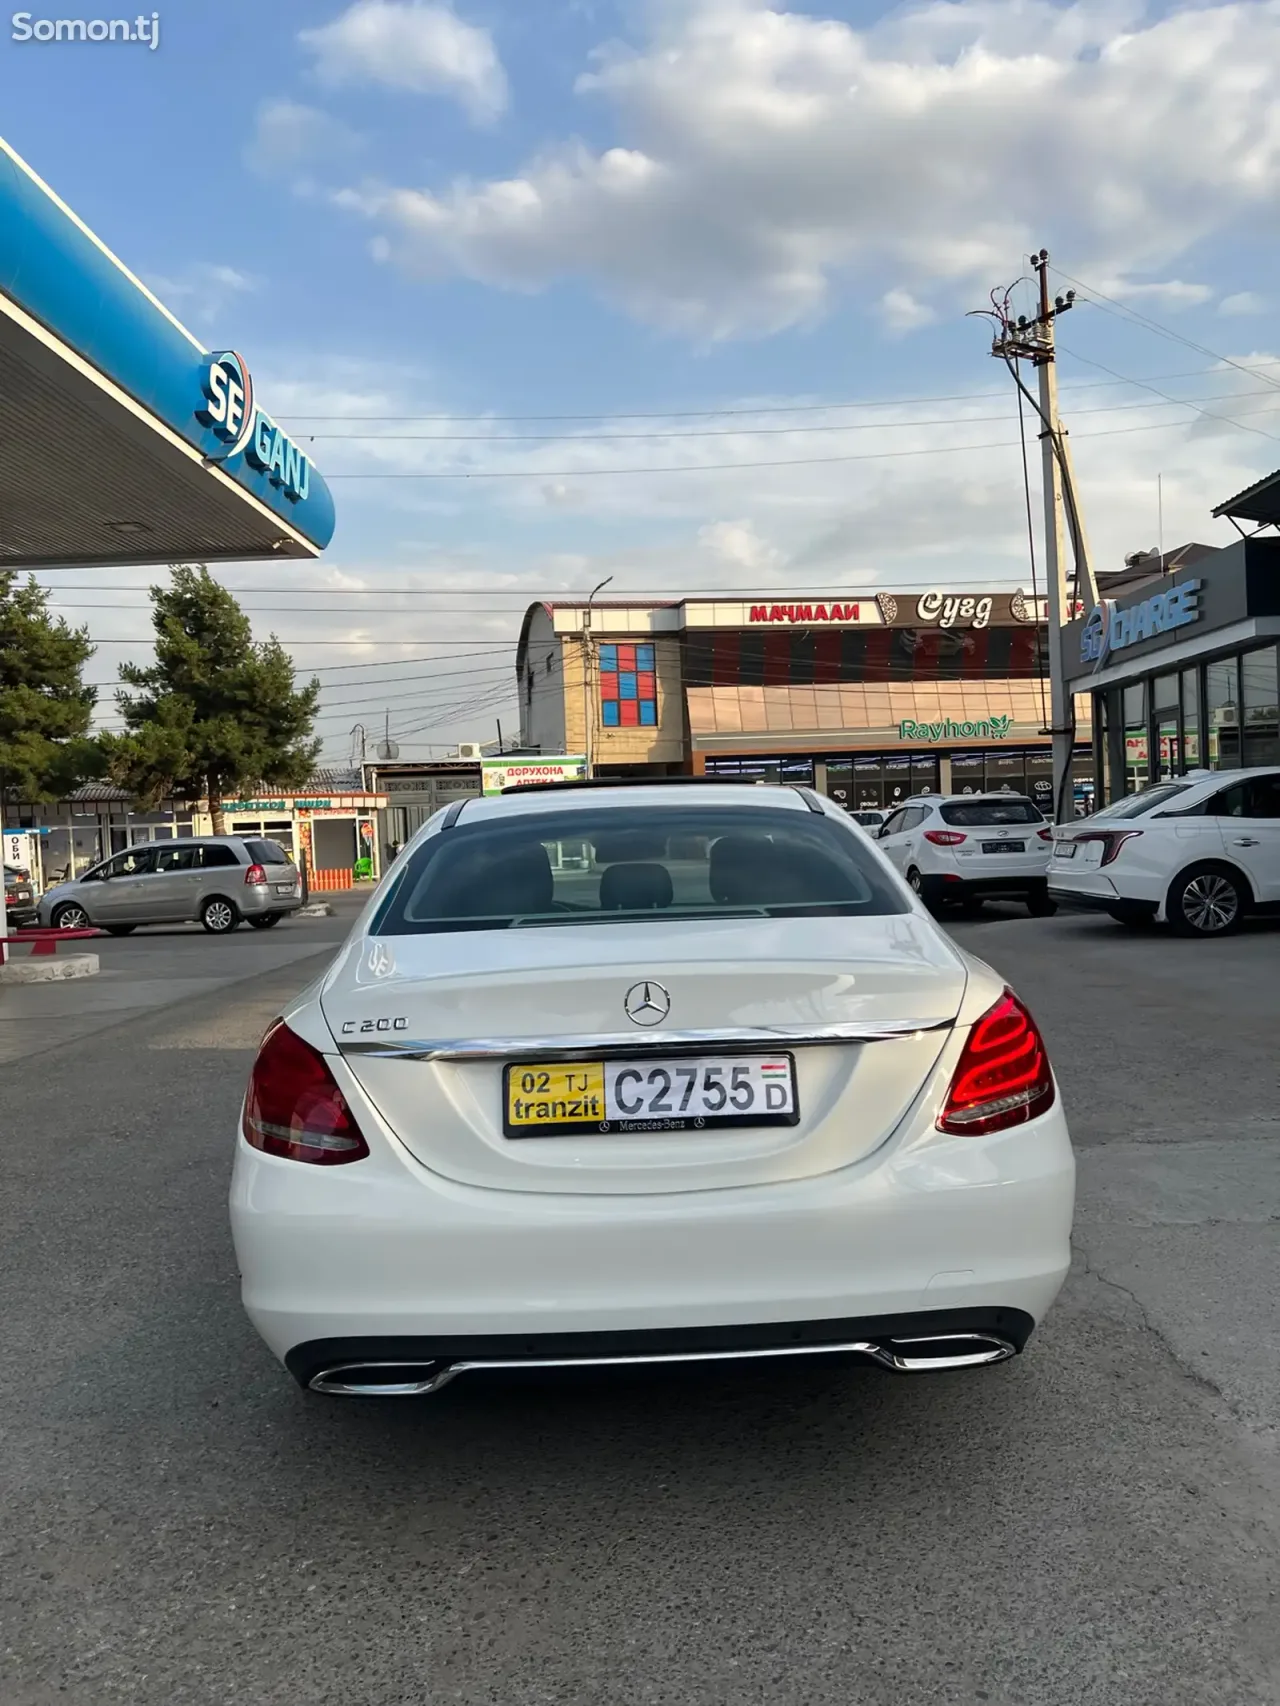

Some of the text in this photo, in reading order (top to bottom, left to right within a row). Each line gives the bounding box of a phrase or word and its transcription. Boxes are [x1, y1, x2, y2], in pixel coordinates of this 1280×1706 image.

[255, 411, 309, 500] GANJ
[1110, 579, 1202, 651] CHARGE
[900, 717, 990, 743] Rayhon
[507, 767, 563, 776] ДОРУХОНА
[11, 836, 20, 860] ОБИ
[342, 1017, 409, 1034] C 200
[521, 1073, 588, 1094] 02 TJ
[614, 1066, 787, 1115] C2755 D
[514, 1095, 599, 1119] tranzit
[619, 1118, 685, 1132] Mercedes-Benz
